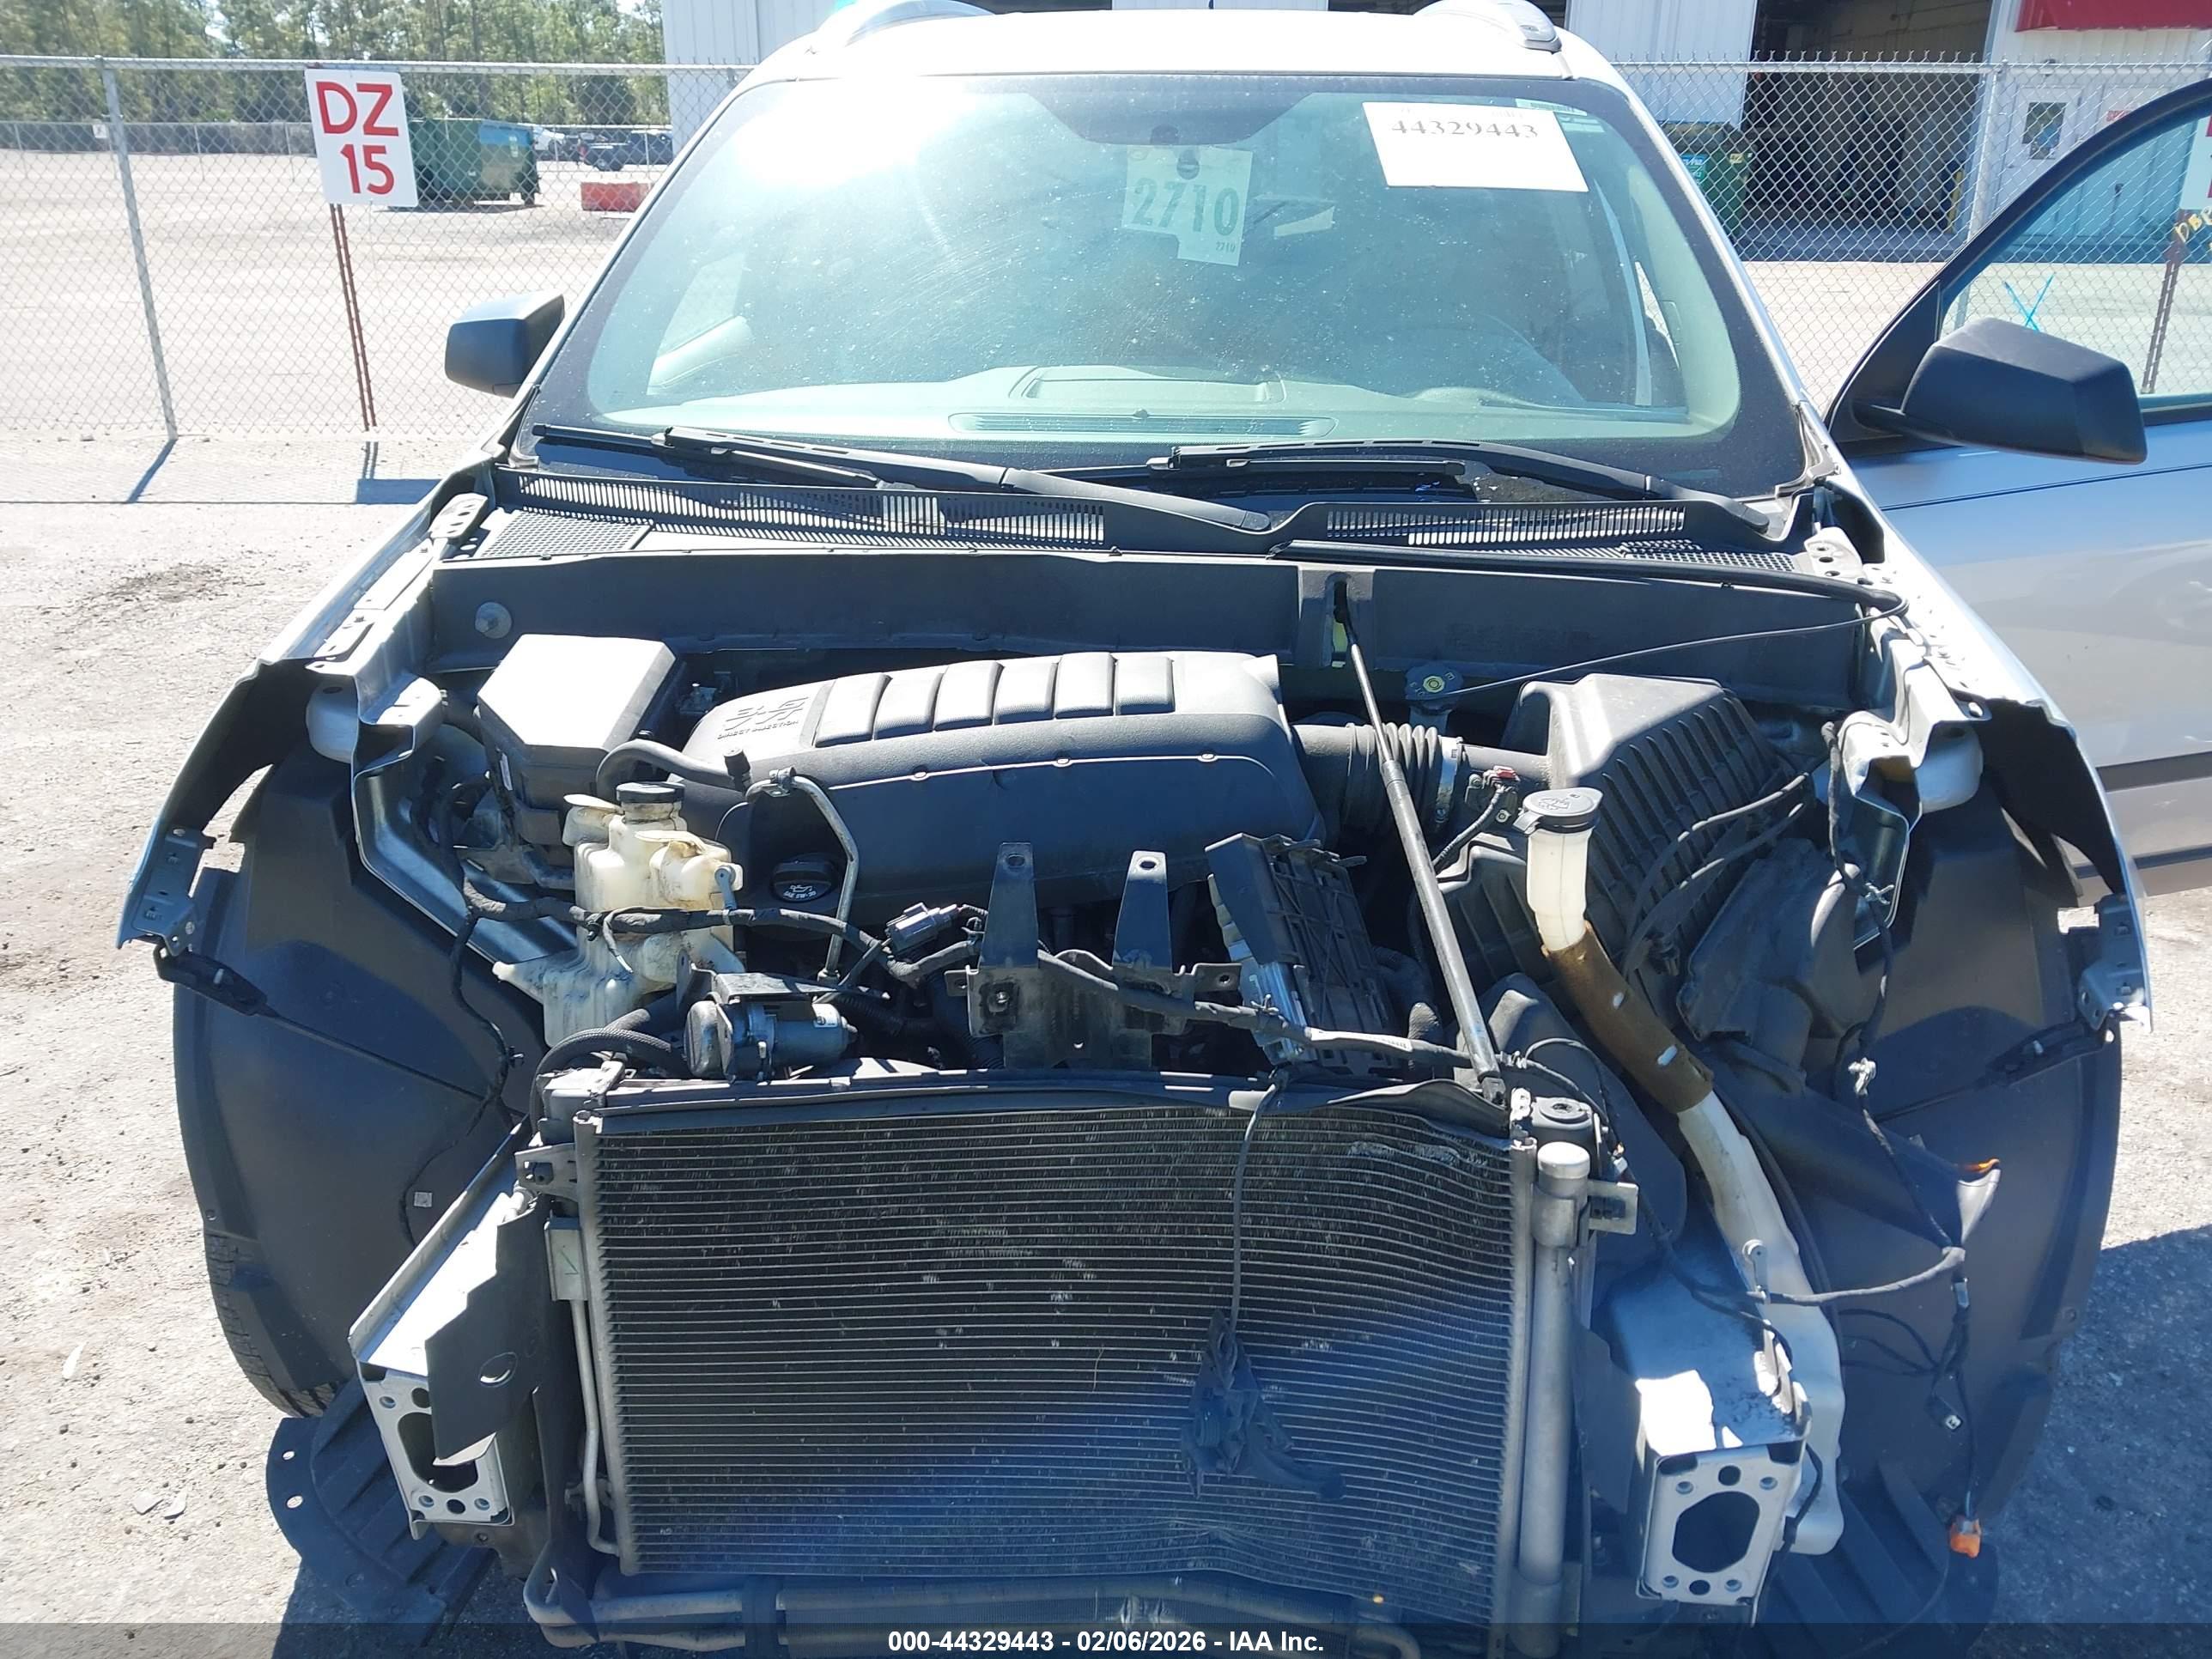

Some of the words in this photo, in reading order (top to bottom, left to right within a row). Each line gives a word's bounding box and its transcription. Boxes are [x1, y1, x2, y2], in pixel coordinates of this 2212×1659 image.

[316, 82, 399, 137] DZ
[1392, 119, 1539, 138] 44329443
[340, 144, 394, 195] 15
[1130, 178, 1240, 236] 2710
